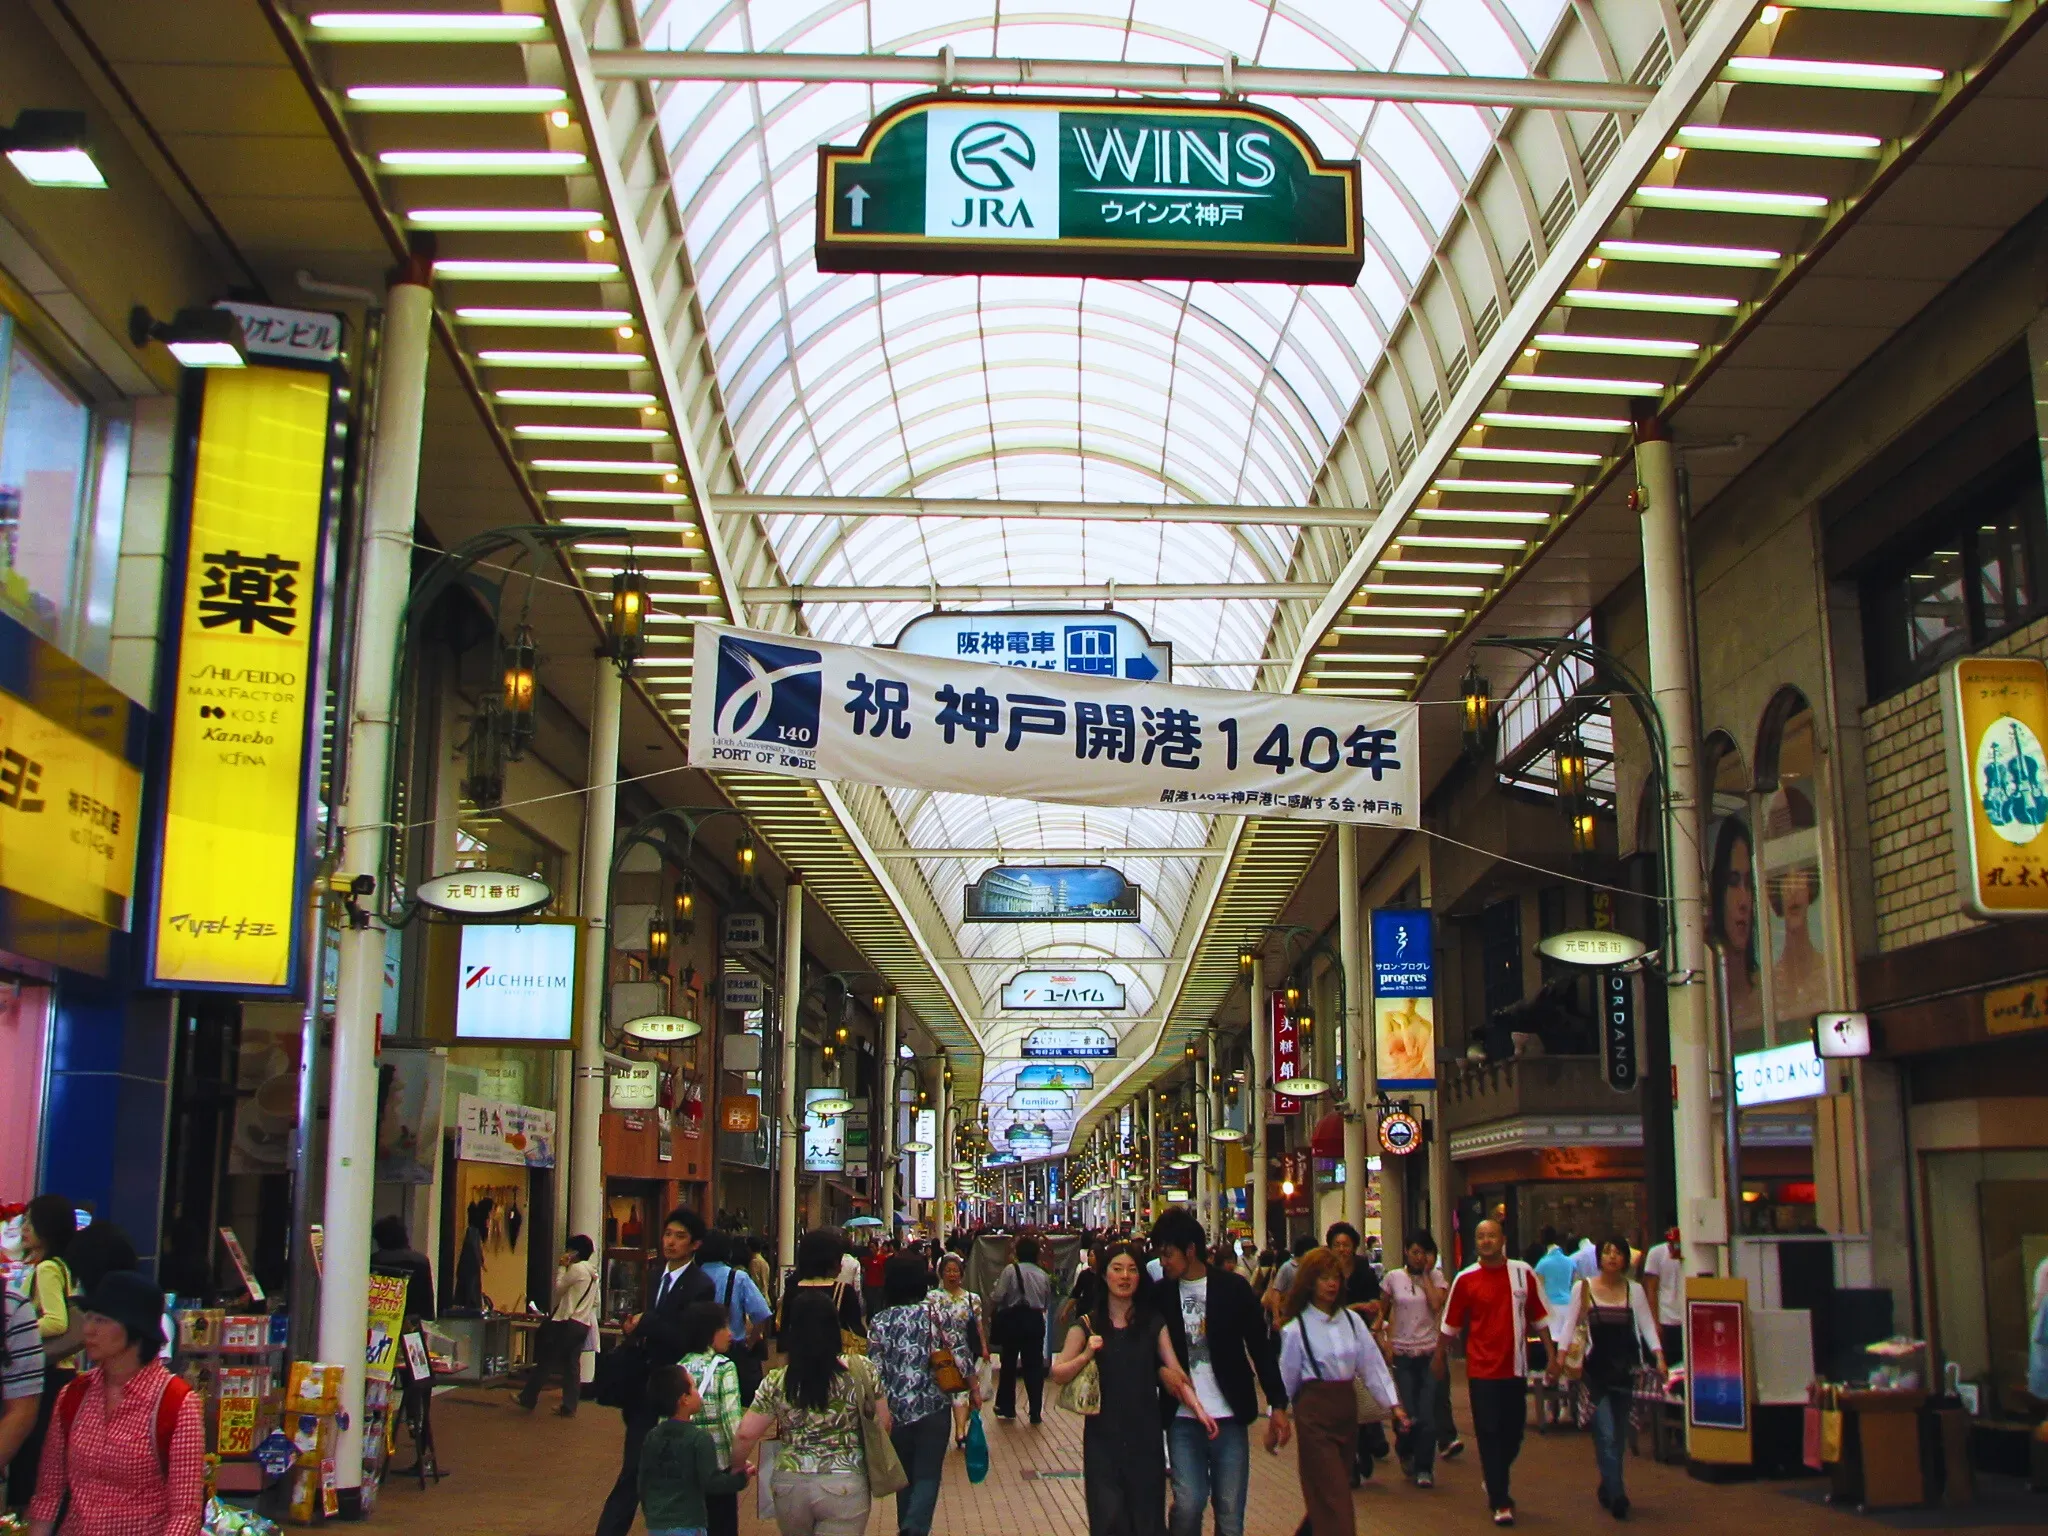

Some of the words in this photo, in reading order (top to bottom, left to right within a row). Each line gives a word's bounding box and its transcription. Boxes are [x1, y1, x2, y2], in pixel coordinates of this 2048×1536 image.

[1073, 127, 1275, 188] WINS
[951, 197, 1034, 229] JRA
[1101, 200, 1244, 226] ウインズ神戸
[198, 551, 299, 636] 薬
[957, 631, 1055, 655] 阪神電車
[190, 664, 295, 686] SHISEIDO
[202, 727, 275, 745] Kanebo
[778, 725, 811, 743] 140
[844, 672, 911, 739] 祝
[935, 683, 1402, 781] 神戸開港140年
[712, 748, 751, 761] PORT
[756, 752, 774, 764] OF
[780, 754, 817, 770] KOBE
[447, 884, 520, 899] 元町1番街
[1092, 908, 1136, 917] CONTAX
[169, 913, 277, 940] マツモトキヨシ
[1566, 940, 1621, 953] 元町1番街
[1380, 974, 1427, 985] progres
[1043, 988, 1104, 1002] ユーハイム
[1735, 1057, 1822, 1092] GIORDANO
[612, 1084, 655, 1099] ABC
[1022, 1097, 1058, 1106] familiar
[808, 1144, 841, 1158] 大上
